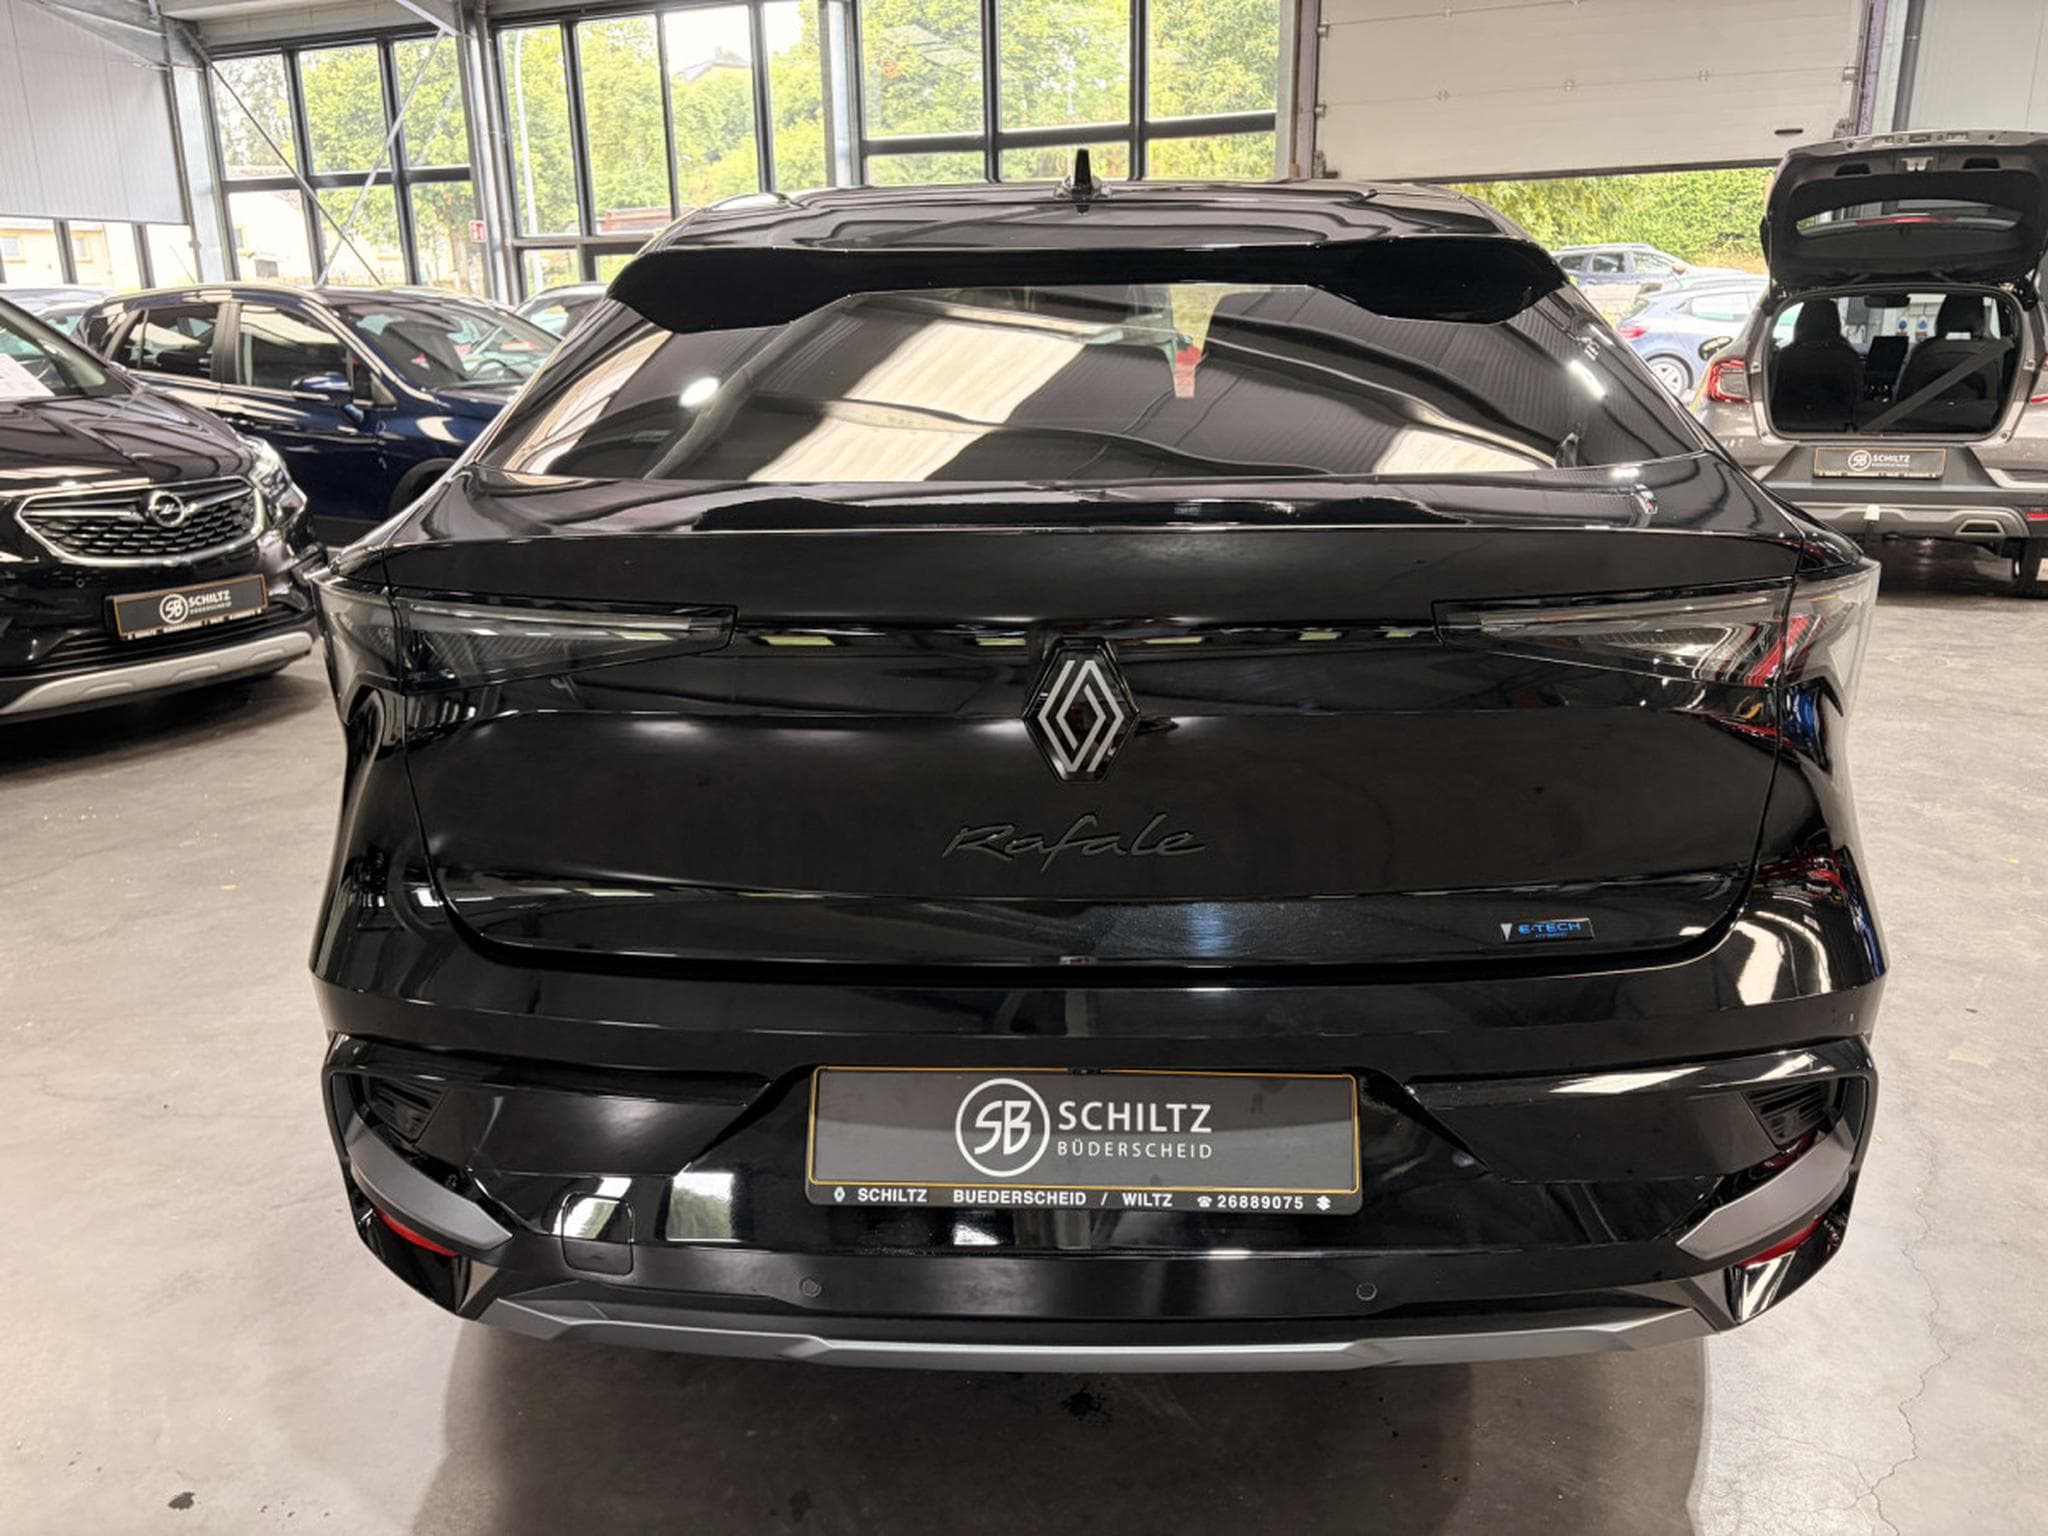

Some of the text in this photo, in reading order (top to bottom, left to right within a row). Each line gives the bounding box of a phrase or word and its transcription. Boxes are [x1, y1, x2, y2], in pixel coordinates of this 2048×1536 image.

[165, 600, 183, 618] SB
[188, 589, 231, 607] SCHILTZ
[943, 812, 1206, 872] Rafale
[974, 1100, 1032, 1155] SB
[1058, 1101, 1212, 1133] SCHILTZ
[1057, 1139, 1212, 1159] BÜDERSCHEID
[857, 1188, 1304, 1210] SCHILTZ BUEDERSCHEID / WILTZ 26889075
